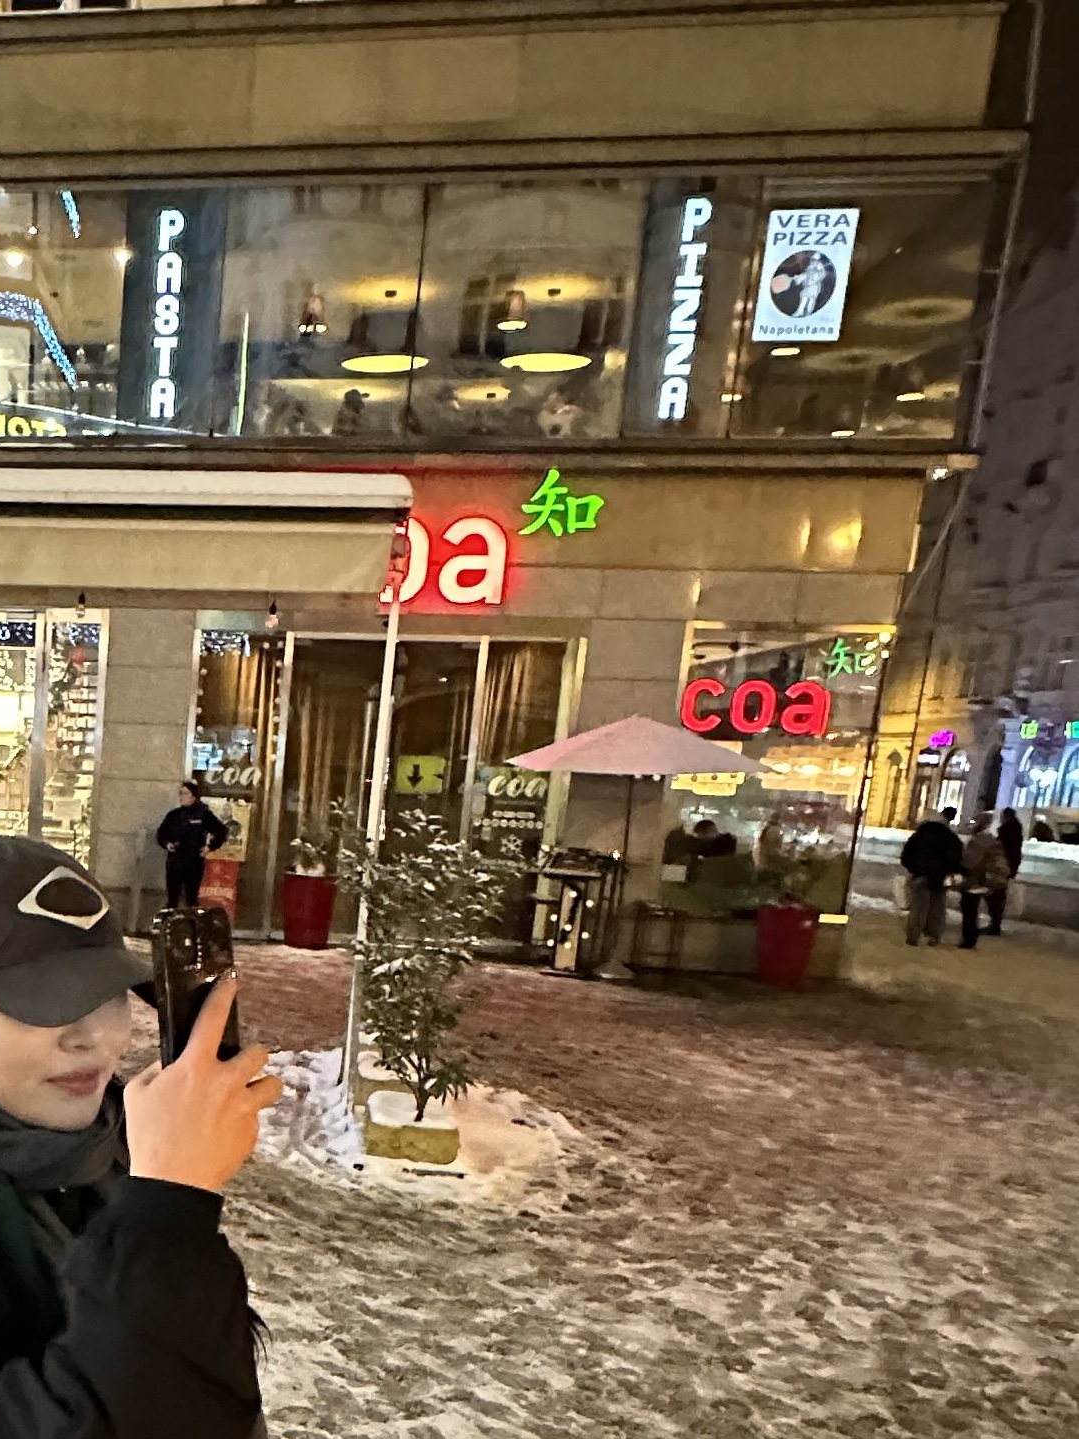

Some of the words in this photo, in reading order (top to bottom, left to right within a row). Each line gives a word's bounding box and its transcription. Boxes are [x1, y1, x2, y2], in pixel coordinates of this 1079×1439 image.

[773, 231, 848, 246] PIZZA
[777, 213, 851, 229] VERA
[150, 209, 185, 418] PASTA
[658, 197, 713, 419] PIZZA
[759, 324, 834, 336] Napoletana
[518, 468, 605, 537] 知
[680, 677, 831, 738] coa
[488, 774, 549, 799] coa
